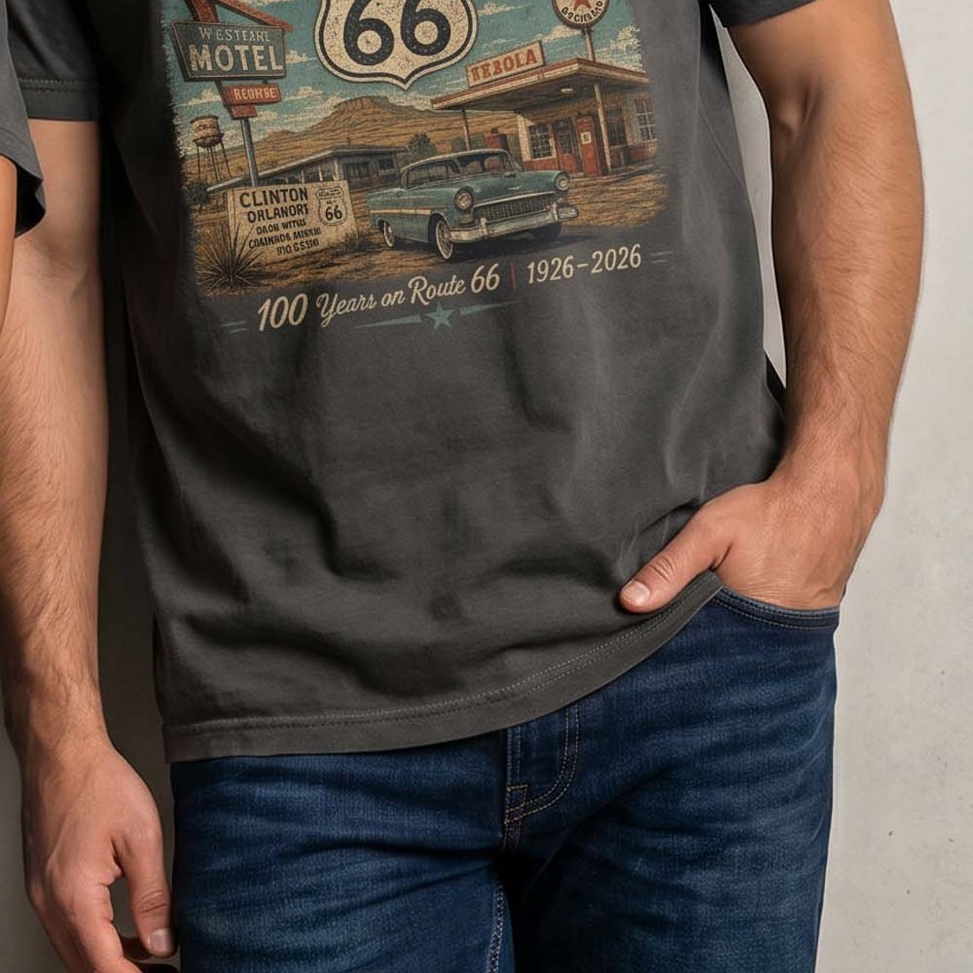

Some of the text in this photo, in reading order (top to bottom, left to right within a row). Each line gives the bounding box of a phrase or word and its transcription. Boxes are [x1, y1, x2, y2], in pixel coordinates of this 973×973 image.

[189, 44, 283, 72] MOTEL
[239, 187, 308, 208] CLINTON
[325, 204, 343, 221] 66
[257, 244, 642, 332] 100 Years on Route 66 1926-2026
